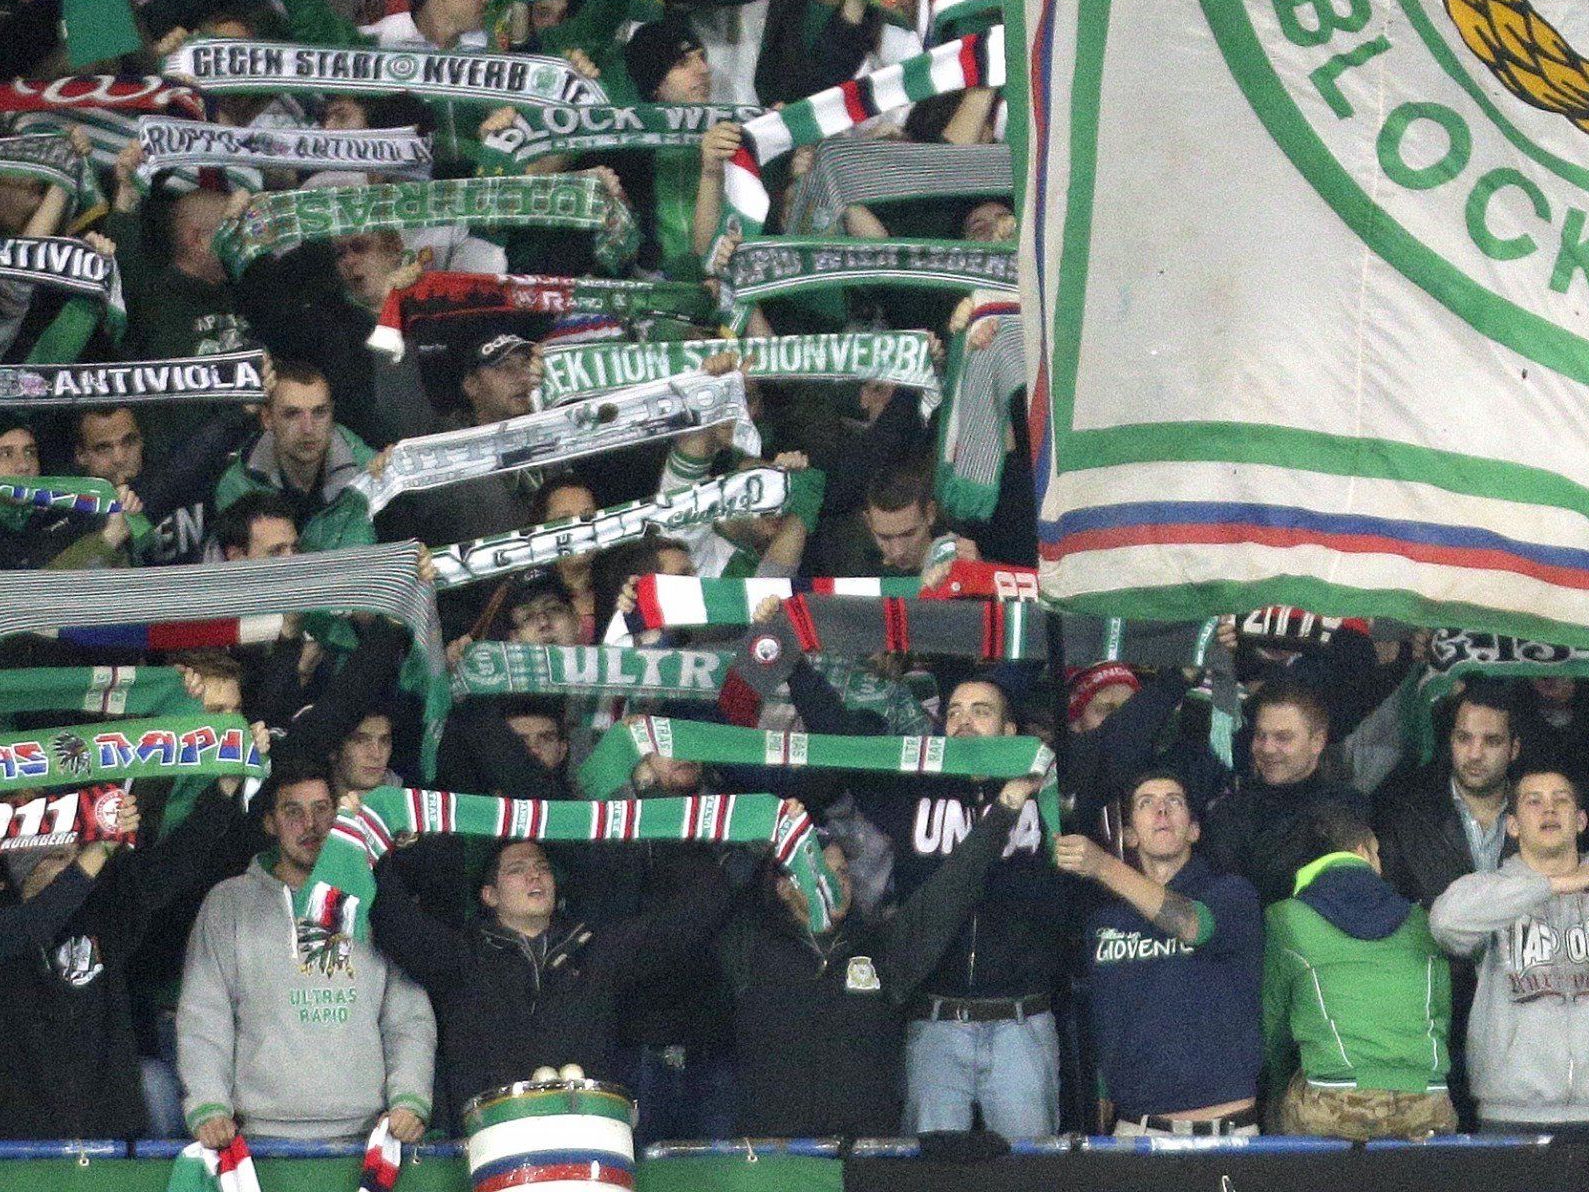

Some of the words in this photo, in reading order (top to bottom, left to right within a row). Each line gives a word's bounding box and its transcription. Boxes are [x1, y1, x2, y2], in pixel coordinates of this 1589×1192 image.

[192, 46, 285, 79] GEGEN
[53, 361, 263, 397] ANTIVIOLA
[289, 987, 358, 1006] ULTRAS
[299, 1006, 349, 1024] RAPID
